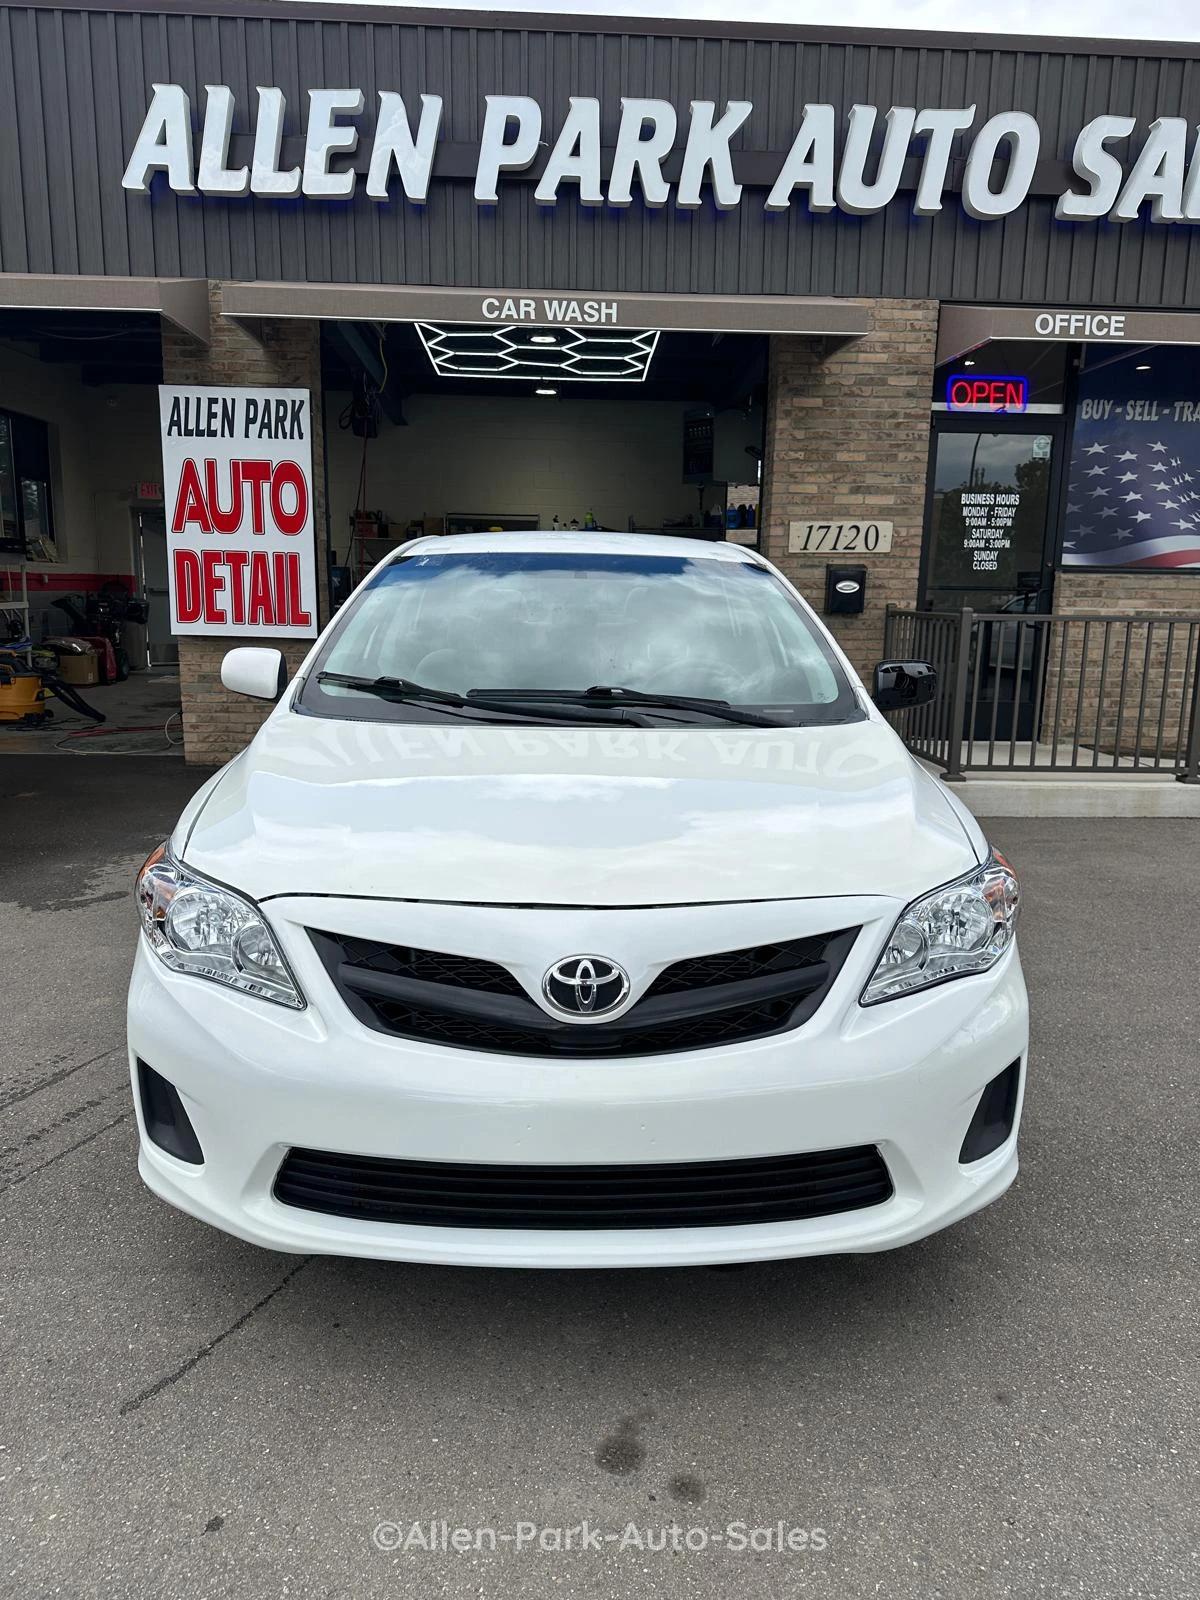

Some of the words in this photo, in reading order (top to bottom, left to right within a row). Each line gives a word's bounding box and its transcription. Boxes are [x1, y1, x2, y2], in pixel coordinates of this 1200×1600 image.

[122, 83, 443, 204] ALLEN
[474, 95, 753, 210] PARK
[764, 104, 1040, 220] AUTO
[481, 298, 537, 320] CAR
[543, 300, 618, 323] WASH
[1035, 313, 1126, 337] OFFICE
[951, 381, 1024, 409] OPEN
[167, 396, 236, 438] ALLEN
[244, 398, 305, 440] PARK
[1081, 399, 1113, 420] BUY
[1125, 400, 1159, 421] SELL
[171, 458, 308, 536] AUTO
[961, 493, 995, 505] BUSINESS
[995, 494, 1020, 505] HOURS
[962, 506, 989, 517] MONDAY
[994, 507, 1017, 518] FRIDAY
[965, 517, 987, 526] 9:00AM
[991, 518, 1012, 527] 5:00PM
[799, 524, 880, 551] 17120
[963, 539, 985, 548] 9:00AM
[989, 539, 1011, 548] 3:00PM
[971, 528, 1004, 539] SATURDAY
[972, 561, 998, 570] CLOSED
[973, 550, 999, 561] SUNDAY
[173, 549, 312, 627] DETAIL
